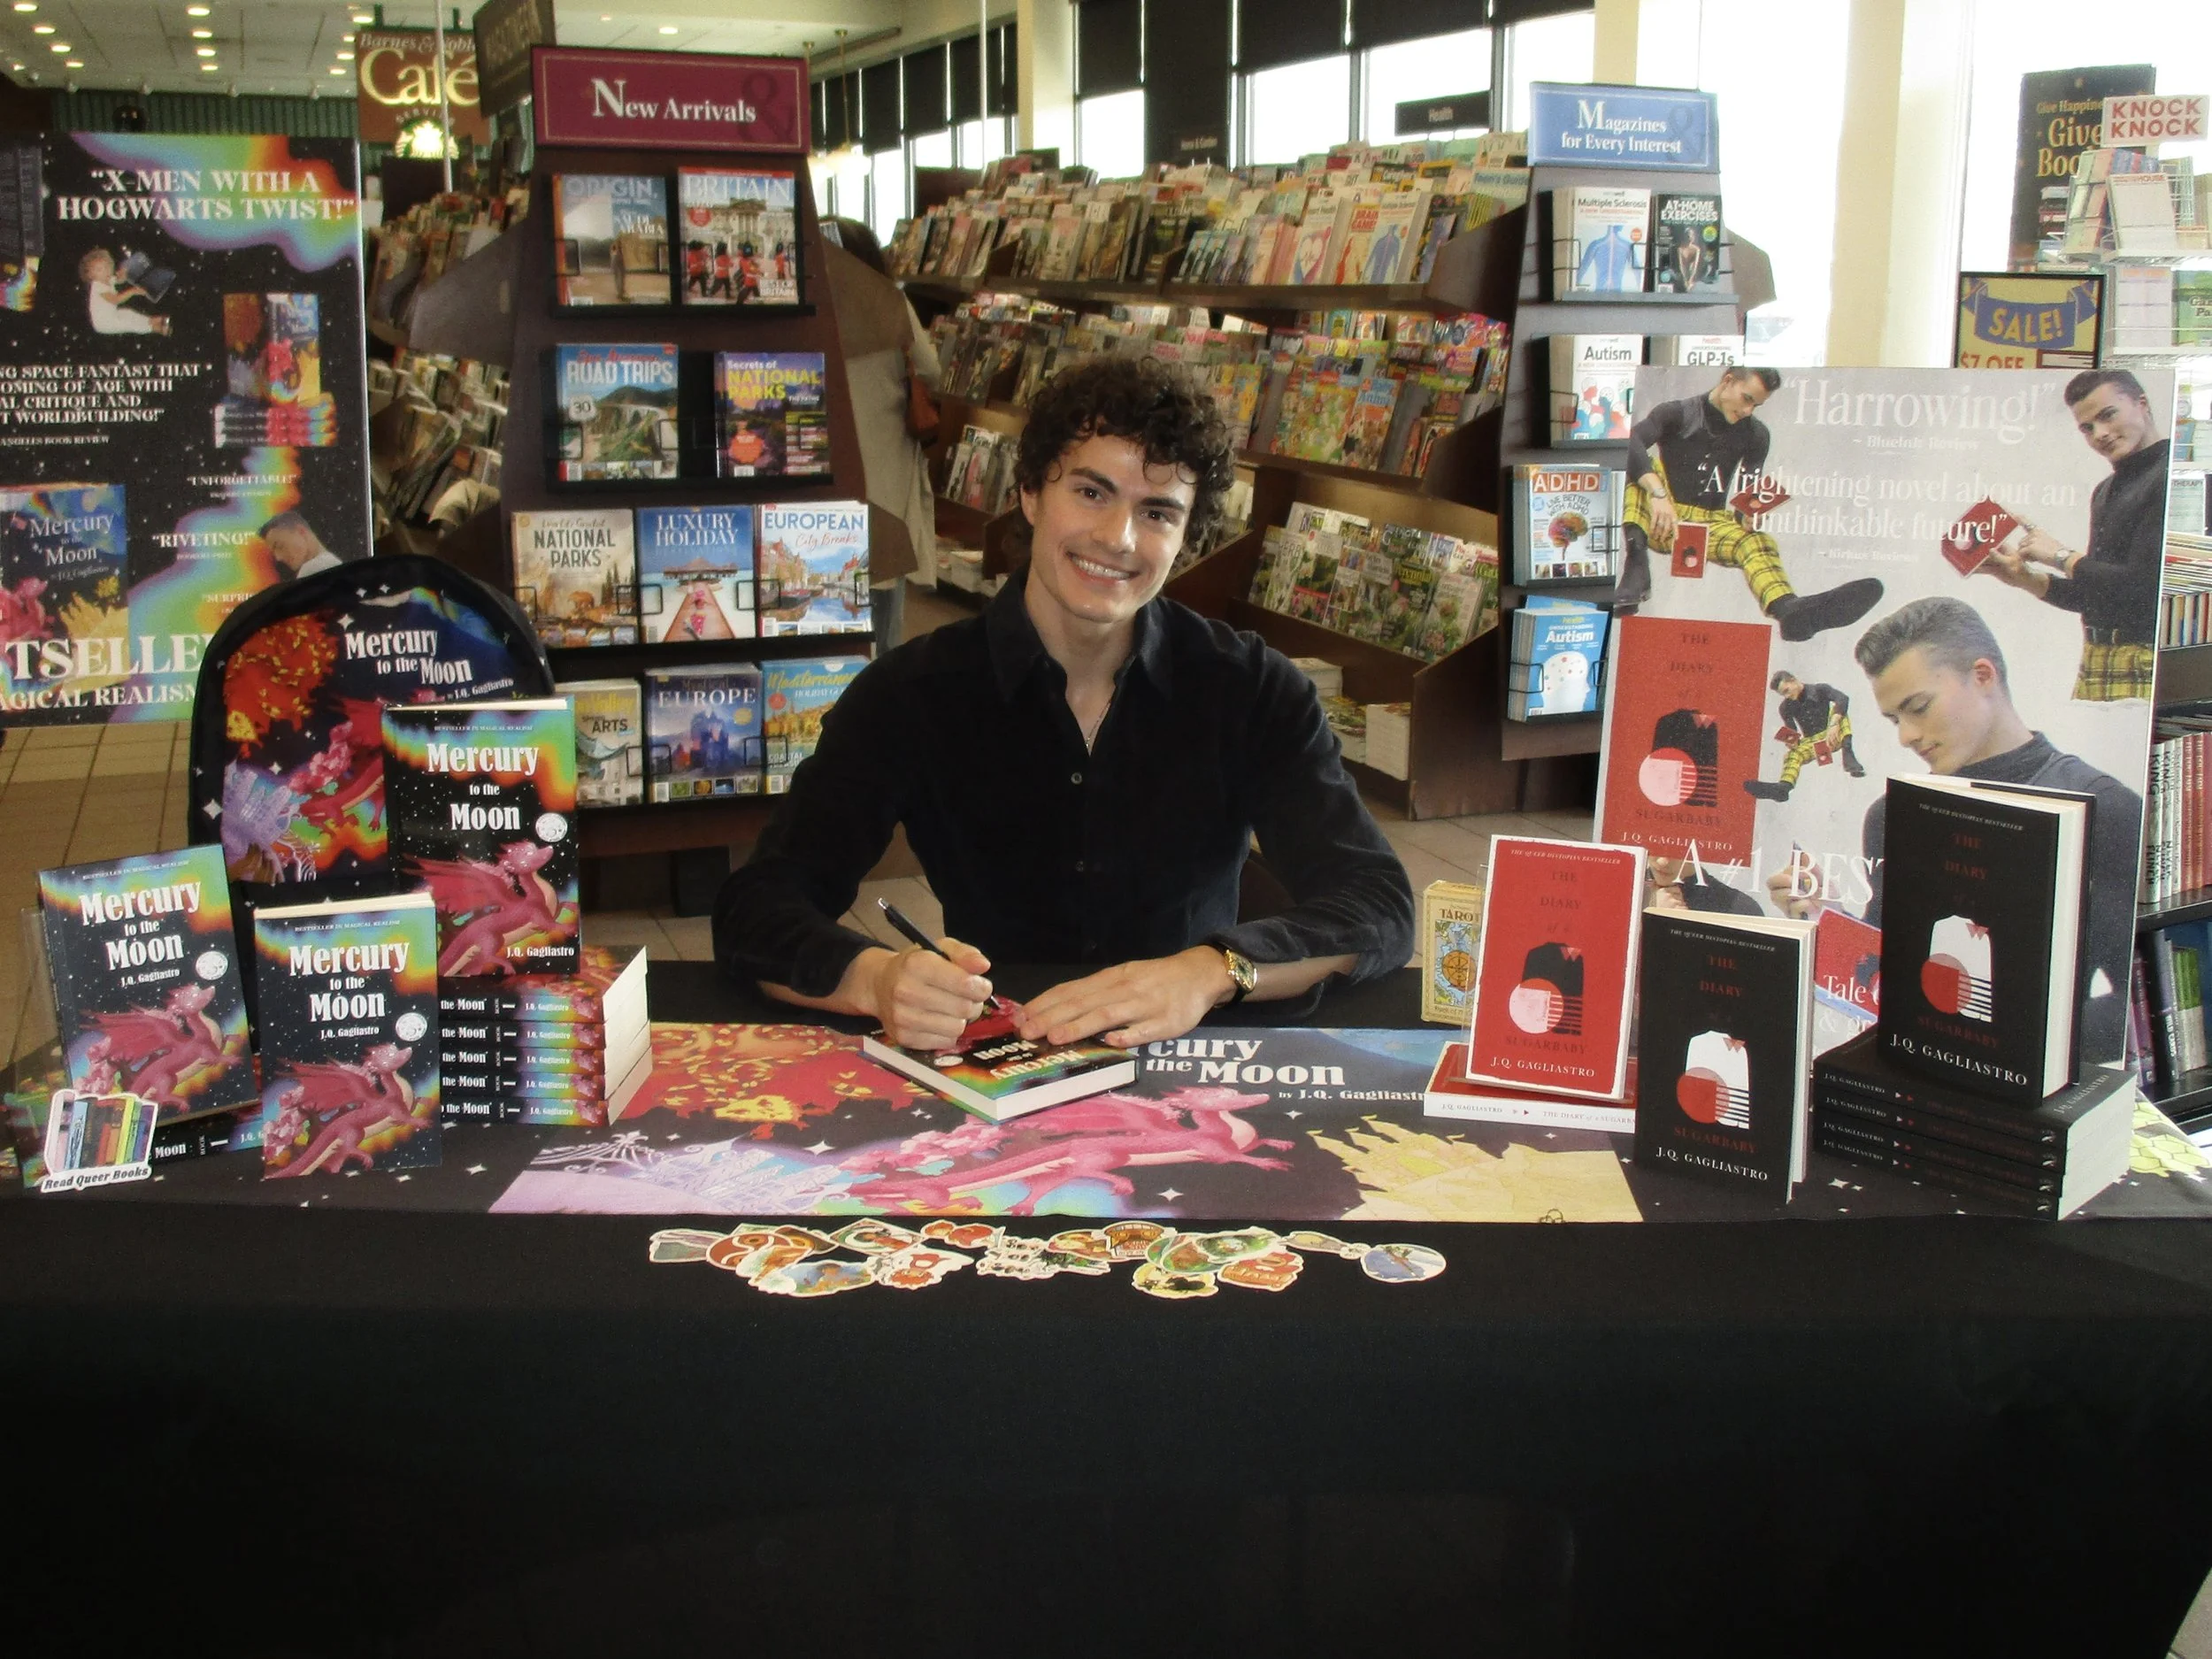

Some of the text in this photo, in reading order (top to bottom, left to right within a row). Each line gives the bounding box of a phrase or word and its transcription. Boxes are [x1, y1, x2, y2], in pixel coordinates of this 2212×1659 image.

[360, 33, 417, 50] Barnes
[591, 78, 757, 123] New Arrivals
[2111, 97, 2203, 119] KNOCK
[1577, 98, 1667, 134] Magazines
[2047, 116, 2101, 149] Give
[2110, 118, 2201, 139] KNOCK
[1561, 132, 1682, 157] for Every Interest
[211, 170, 290, 192] WITH
[299, 171, 322, 192] A
[686, 176, 791, 202] BRITAIN
[57, 196, 234, 220] HOGWARTS
[1578, 197, 1647, 209] Multiple Sclerosis
[1664, 199, 1715, 211] AT-HOME
[1660, 210, 1718, 221] EXERCISES
[1987, 307, 2065, 343] SALE!
[1584, 345, 1632, 361] Autism
[1686, 350, 1734, 366] GLP-1s
[21, 363, 201, 380] SPACE FANTASY THAT
[566, 360, 673, 385] ROAD TRIPS
[727, 359, 777, 370] Secrets of
[64, 380, 86, 394] OF
[92, 379, 126, 394] AGE
[128, 379, 173, 393] WITH
[728, 369, 821, 385] NATIONAL
[728, 384, 786, 400] PARKS
[23, 394, 142, 411] CRITIQUE AND
[573, 401, 591, 413] 30
[1532, 472, 1600, 493] ADHD
[1734, 465, 1870, 508] frightening
[1879, 471, 1955, 503] novel
[1955, 472, 2035, 505] about
[2040, 484, 2078, 508] an
[1563, 494, 1591, 506] BETTER
[29, 511, 115, 539] Mercury
[657, 512, 736, 531] LUXURY
[764, 512, 864, 530] EUROPEAN
[1751, 503, 1902, 539] unthinkable
[534, 528, 616, 549] NATIONAL
[656, 528, 739, 547] HOLIDAY
[796, 533, 818, 552] City
[45, 547, 98, 567] Moon
[549, 549, 602, 568] PARKS
[344, 628, 438, 661] Mercury
[1546, 629, 1594, 643] Autism
[4, 631, 215, 681] TSELLE
[376, 656, 419, 675] to the
[419, 657, 472, 686] Moon
[471, 677, 514, 697] Gagliastro
[658, 687, 757, 708] EUROPE
[592, 718, 628, 733] ARTS
[426, 741, 539, 777] Mercury
[2149, 754, 2161, 796] KING
[469, 783, 501, 795] to the
[449, 802, 521, 832] Moon
[1648, 833, 1732, 852] GAGLIASTRO
[1953, 832, 1983, 849] THE
[1524, 849, 1544, 858] QUEER
[1581, 855, 1621, 864] BESTSELLER
[1672, 837, 1709, 888] A
[1718, 843, 1763, 895] #1
[1549, 869, 1578, 883] THE
[1945, 859, 1989, 880] DIARY
[78, 880, 202, 926] Mercury
[1540, 895, 1582, 910] DIARY
[1439, 908, 1481, 923] TAROT
[124, 919, 161, 937] to the
[104, 933, 185, 972] Moon
[288, 941, 410, 977] Mercury
[506, 945, 575, 959] J.Q. Gagliastro
[1708, 955, 1736, 969] THE
[137, 967, 180, 985] Gagliastro
[329, 976, 365, 991] to the
[1699, 979, 1742, 998] DIARY
[1823, 973, 1867, 1004] Tale
[310, 992, 386, 1023] Moon
[441, 998, 486, 1011] the Moon
[320, 1025, 380, 1041] J.Q. Gagliastro
[442, 1026, 487, 1039] the Moon
[1916, 1016, 2000, 1049] SUGARBABY
[972, 1040, 1039, 1060] Moon
[1504, 1033, 1587, 1056] SUGARBABY
[989, 1049, 1087, 1080] Mercury
[1146, 1058, 1346, 1086] the Moon
[1517, 1060, 1596, 1079] GAGLIASTRO
[1921, 1044, 2029, 1087] GAGLIASTRO
[1839, 1075, 1886, 1094] GAGLIASTRO
[1279, 1089, 1333, 1101] by J.Q.
[446, 1102, 490, 1115] the Moon
[1456, 1104, 1503, 1113] GAGLIASTRO
[1560, 1111, 1584, 1120] DIARY
[1840, 1100, 1887, 1118] GAGLIASTRO
[154, 1141, 187, 1158] Moon
[1673, 1125, 1758, 1155] SUGARBABY
[1684, 1152, 1769, 1182] GAGLIASTRO
[42, 1164, 150, 1192] Read Queer Books
